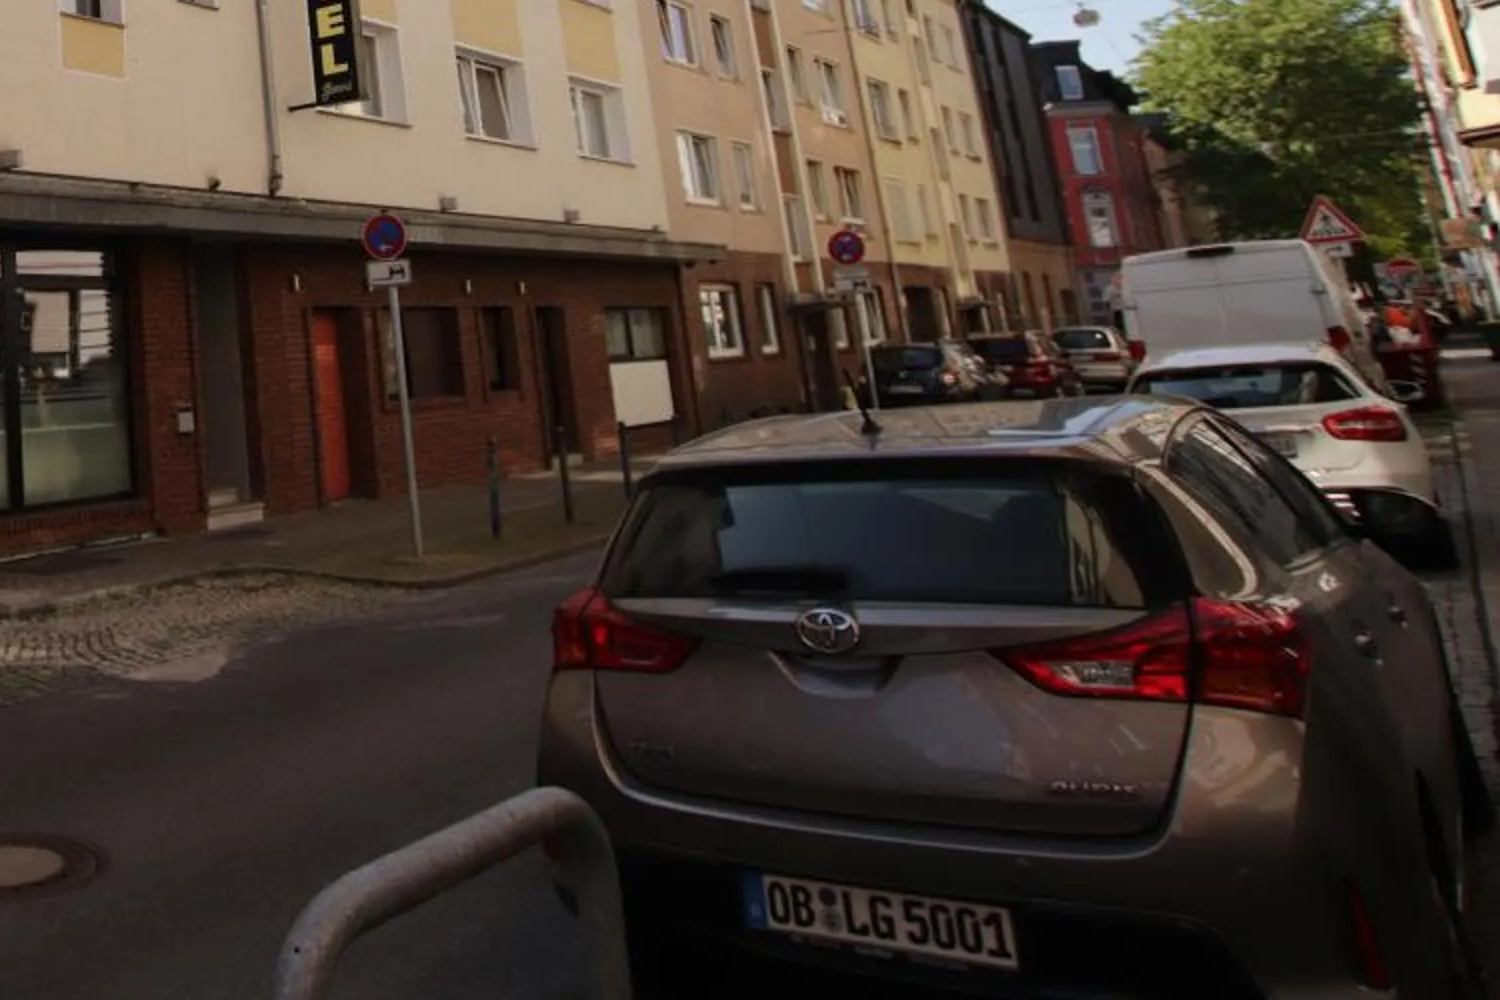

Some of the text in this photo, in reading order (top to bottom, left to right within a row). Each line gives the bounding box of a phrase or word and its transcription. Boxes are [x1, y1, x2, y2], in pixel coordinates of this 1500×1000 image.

[768, 882, 1013, 959] OB LG 5001
